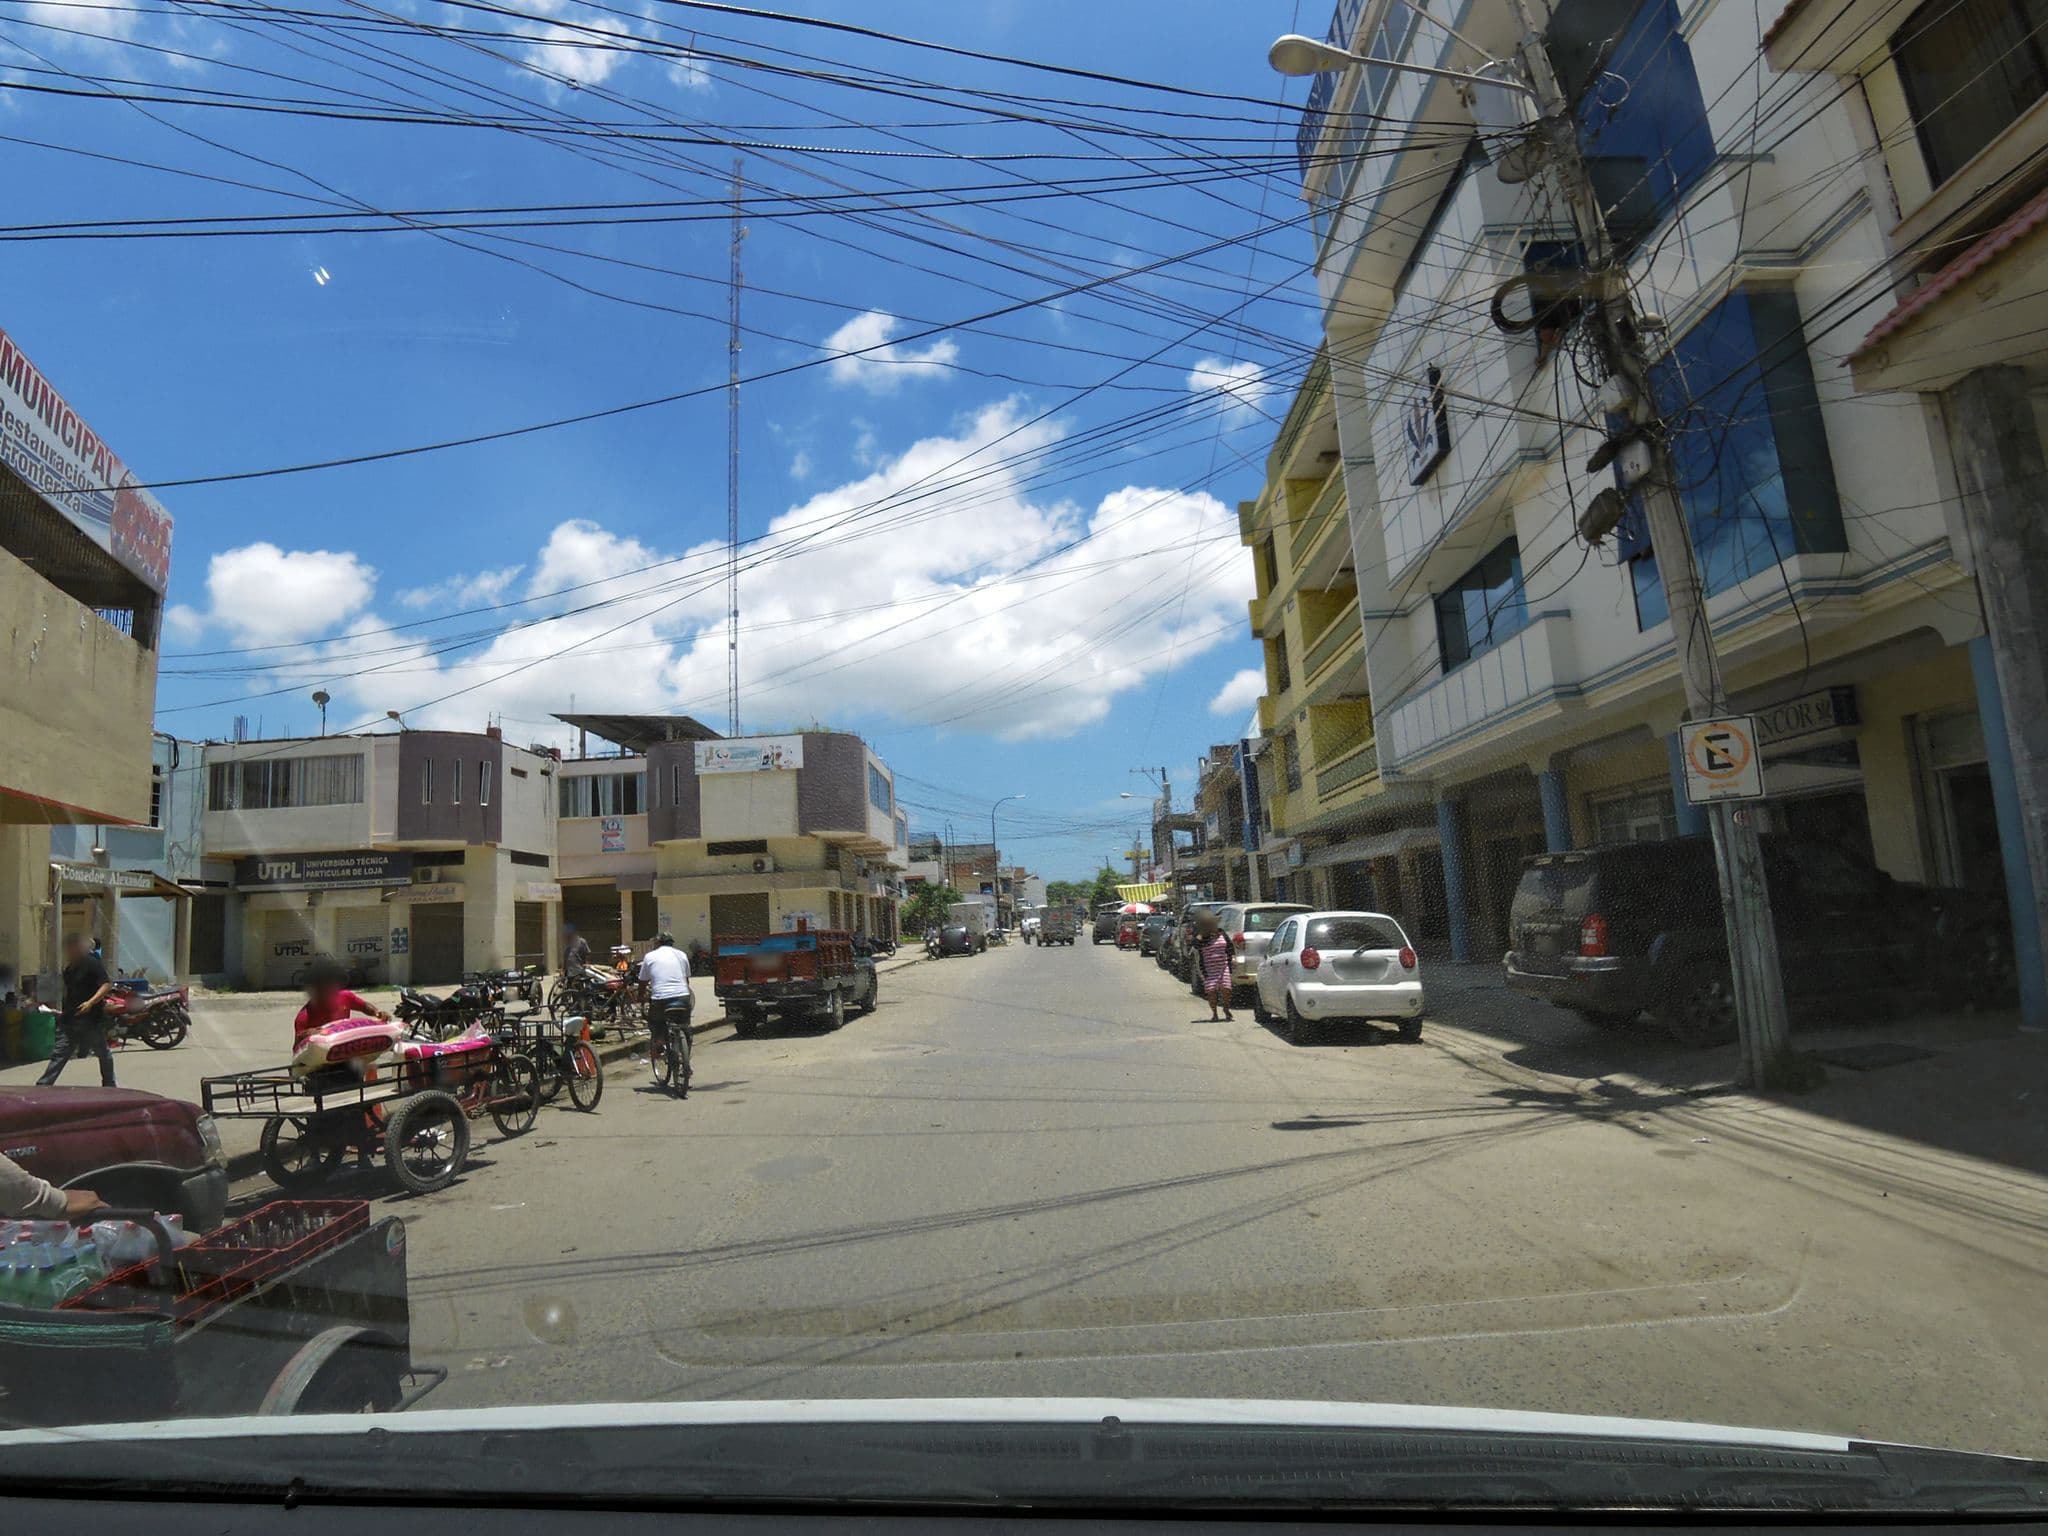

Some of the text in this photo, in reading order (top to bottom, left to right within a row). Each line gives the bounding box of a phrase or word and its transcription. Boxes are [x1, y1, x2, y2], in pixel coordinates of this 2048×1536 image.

[0, 340, 115, 488] MUNICIPAL
[1, 433, 81, 512] Fronteriza
[258, 862, 302, 880] UTPL
[306, 859, 354, 868] UNIVERSIDAD
[62, 865, 151, 888] Comedor Alexandra
[306, 867, 383, 878] PARTICULAR DE LOJA
[274, 944, 310, 956] UTPL
[347, 942, 382, 953] UTPL
